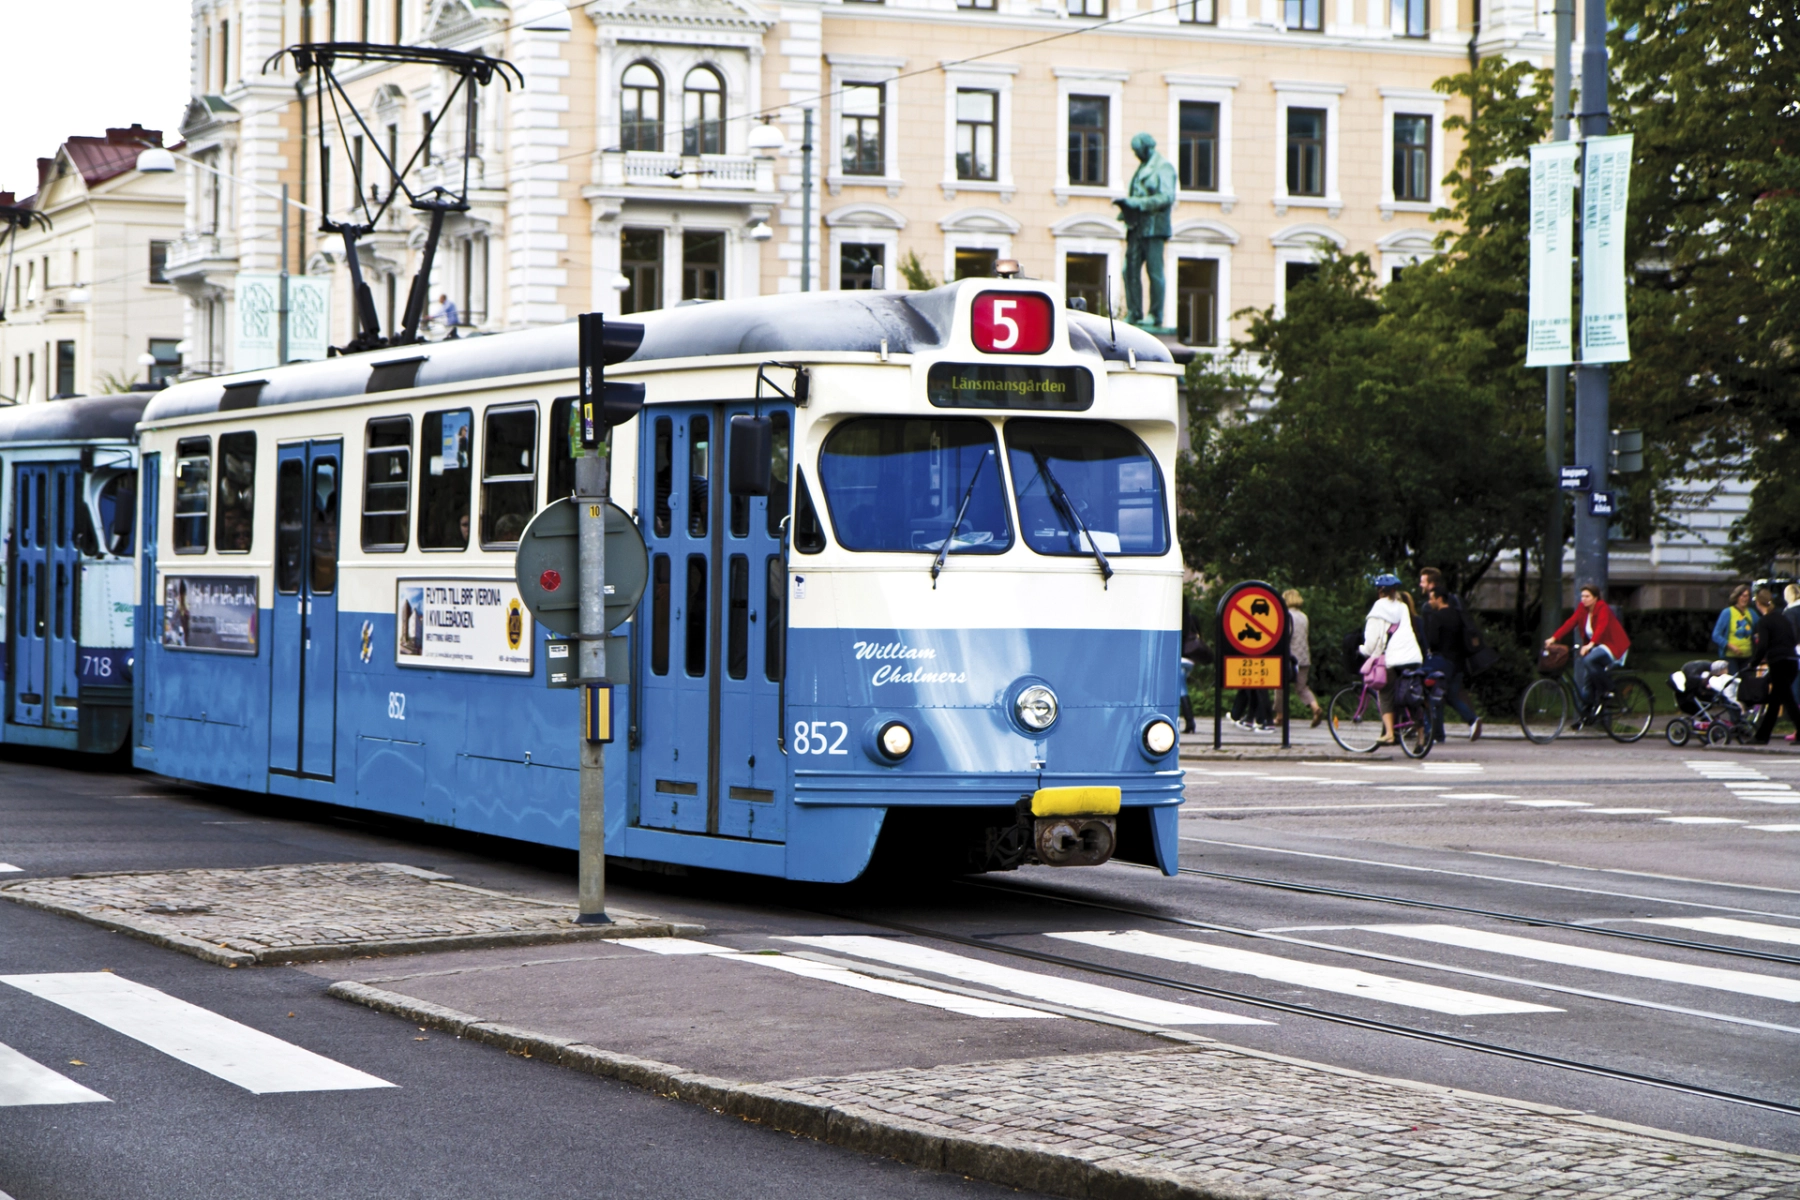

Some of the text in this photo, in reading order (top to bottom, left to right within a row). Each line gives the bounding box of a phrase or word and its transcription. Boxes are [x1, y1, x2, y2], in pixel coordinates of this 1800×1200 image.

[1599, 152, 1615, 248] INTERNATIONELLA
[993, 300, 1019, 349] 5
[952, 375, 1066, 395] Länsmansgården
[590, 505, 600, 517] 10
[426, 587, 501, 606] FLYTTA TILL BRF VERONA
[853, 641, 937, 660] William
[82, 655, 112, 677] 718
[872, 665, 968, 686] Chalmers
[388, 691, 406, 720] 852
[793, 720, 849, 755] 852
